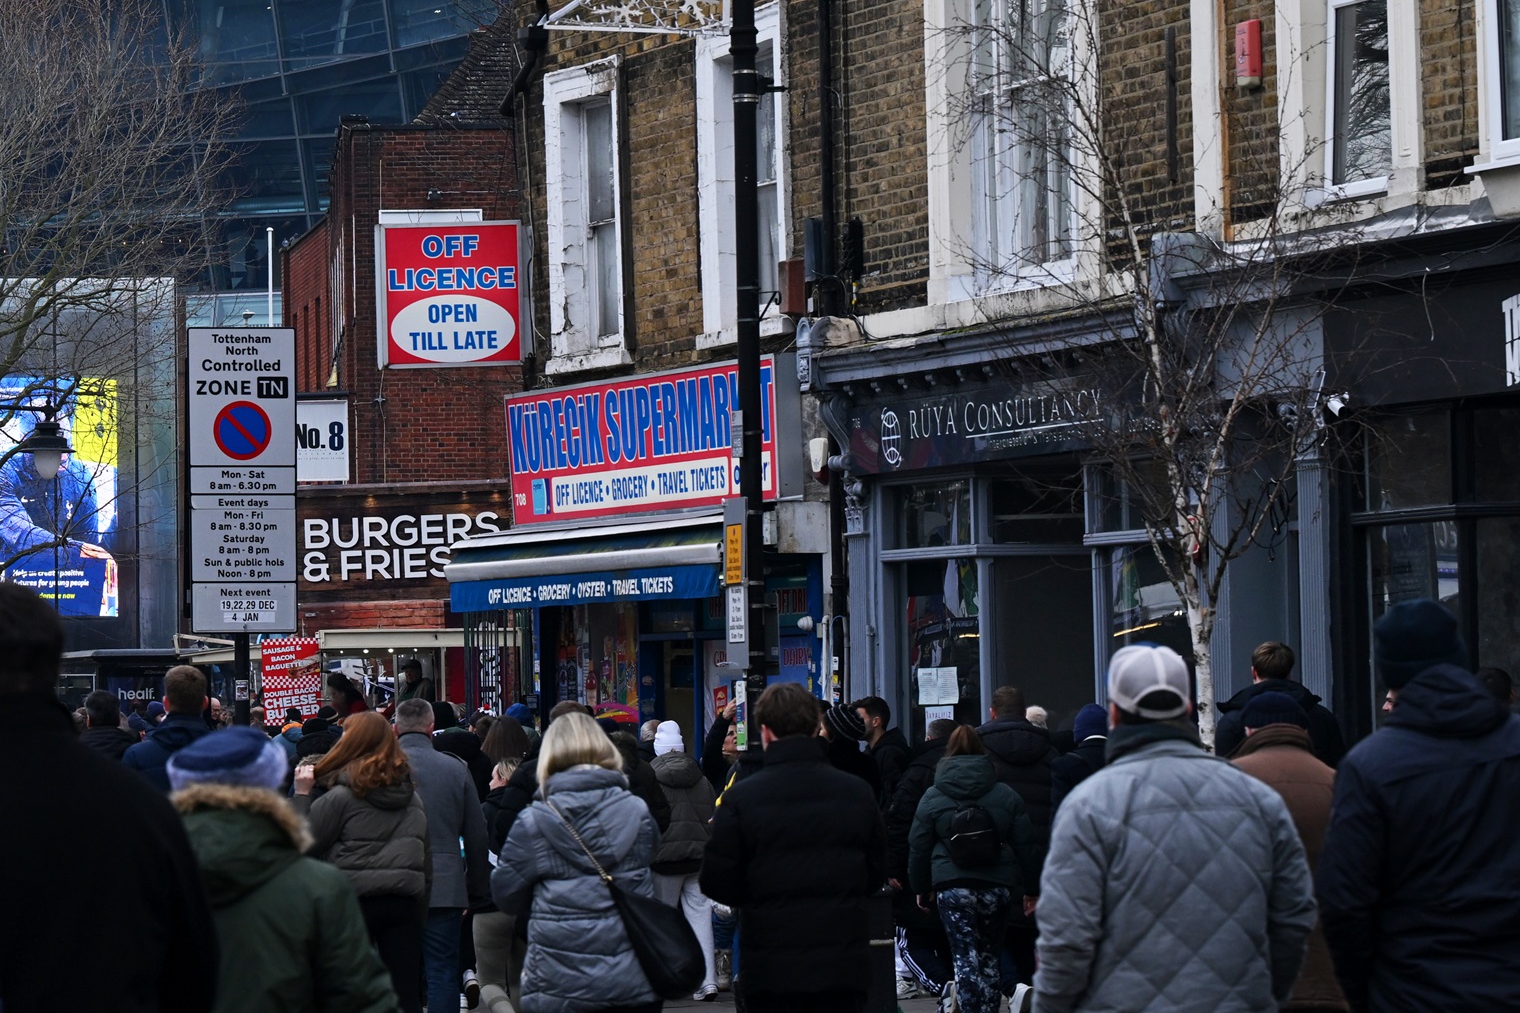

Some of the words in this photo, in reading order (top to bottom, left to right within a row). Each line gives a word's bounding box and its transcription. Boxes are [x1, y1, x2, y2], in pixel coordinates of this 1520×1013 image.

[422, 235, 479, 258] OFF
[388, 266, 516, 291] LICENCE
[428, 304, 478, 324] OPEN
[212, 334, 271, 344] Tottenham
[409, 332, 448, 351] TILL
[454, 330, 498, 350] LATE
[225, 346, 258, 356] North
[202, 359, 281, 372] Controlled
[196, 380, 252, 396] ZONE
[259, 380, 284, 396] TN
[604, 366, 772, 464] SUPERMART
[909, 402, 957, 439] RÜYA
[964, 387, 1103, 432] CONSULTANCY
[296, 424, 326, 449] No.
[329, 421, 344, 451] 8
[221, 470, 241, 479] Mon
[248, 470, 265, 479] Sat
[209, 482, 216, 490] 8
[238, 482, 261, 490] 6.30
[263, 483, 277, 492] pm
[555, 486, 570, 507] OFF
[572, 480, 604, 505] LICENCE
[611, 475, 648, 501] GROCERY
[657, 469, 689, 495] TRAVEL
[690, 465, 725, 491] TICKETS
[218, 499, 245, 507] Event
[247, 499, 269, 509] days
[224, 511, 244, 520] Mon
[251, 511, 264, 520] Fri
[210, 522, 216, 531] 8
[239, 522, 262, 531] 8.30
[263, 524, 278, 533] pm
[303, 511, 500, 549] BURGERS
[223, 535, 265, 545] Saturday
[218, 546, 225, 554] 8
[248, 546, 254, 554] 8
[255, 547, 270, 556] pm
[204, 558, 222, 567] Sun
[225, 558, 231, 567] &
[234, 558, 263, 568] public
[265, 558, 285, 567] hols
[303, 551, 330, 582] &
[340, 545, 453, 581] FRIES
[60, 569, 84, 578] positive
[217, 570, 242, 578] Noon
[249, 569, 255, 578] 8
[257, 570, 271, 579] pm
[38, 578, 48, 588] for
[70, 579, 90, 588] people
[220, 588, 243, 597] Next
[245, 588, 271, 597] event
[488, 589, 501, 605] OFF
[502, 586, 532, 604] LICENCE
[537, 583, 570, 602] GROCERY
[577, 581, 606, 599] OYSTER
[612, 578, 640, 596] TRAVEL
[641, 576, 673, 594] TICKETS
[221, 601, 256, 611] 19,22,29
[258, 600, 275, 610] DEC
[231, 613, 237, 622] 4
[242, 612, 259, 622] JAN
[262, 646, 295, 655] SAUSAGE
[271, 654, 295, 662] BACON
[783, 647, 810, 666] DAIRY
[265, 661, 304, 671] BAGUETTE
[118, 688, 155, 700] healf.
[264, 689, 293, 698] DOUBLE
[294, 686, 320, 695] BACON
[264, 694, 317, 709] CHEESE
